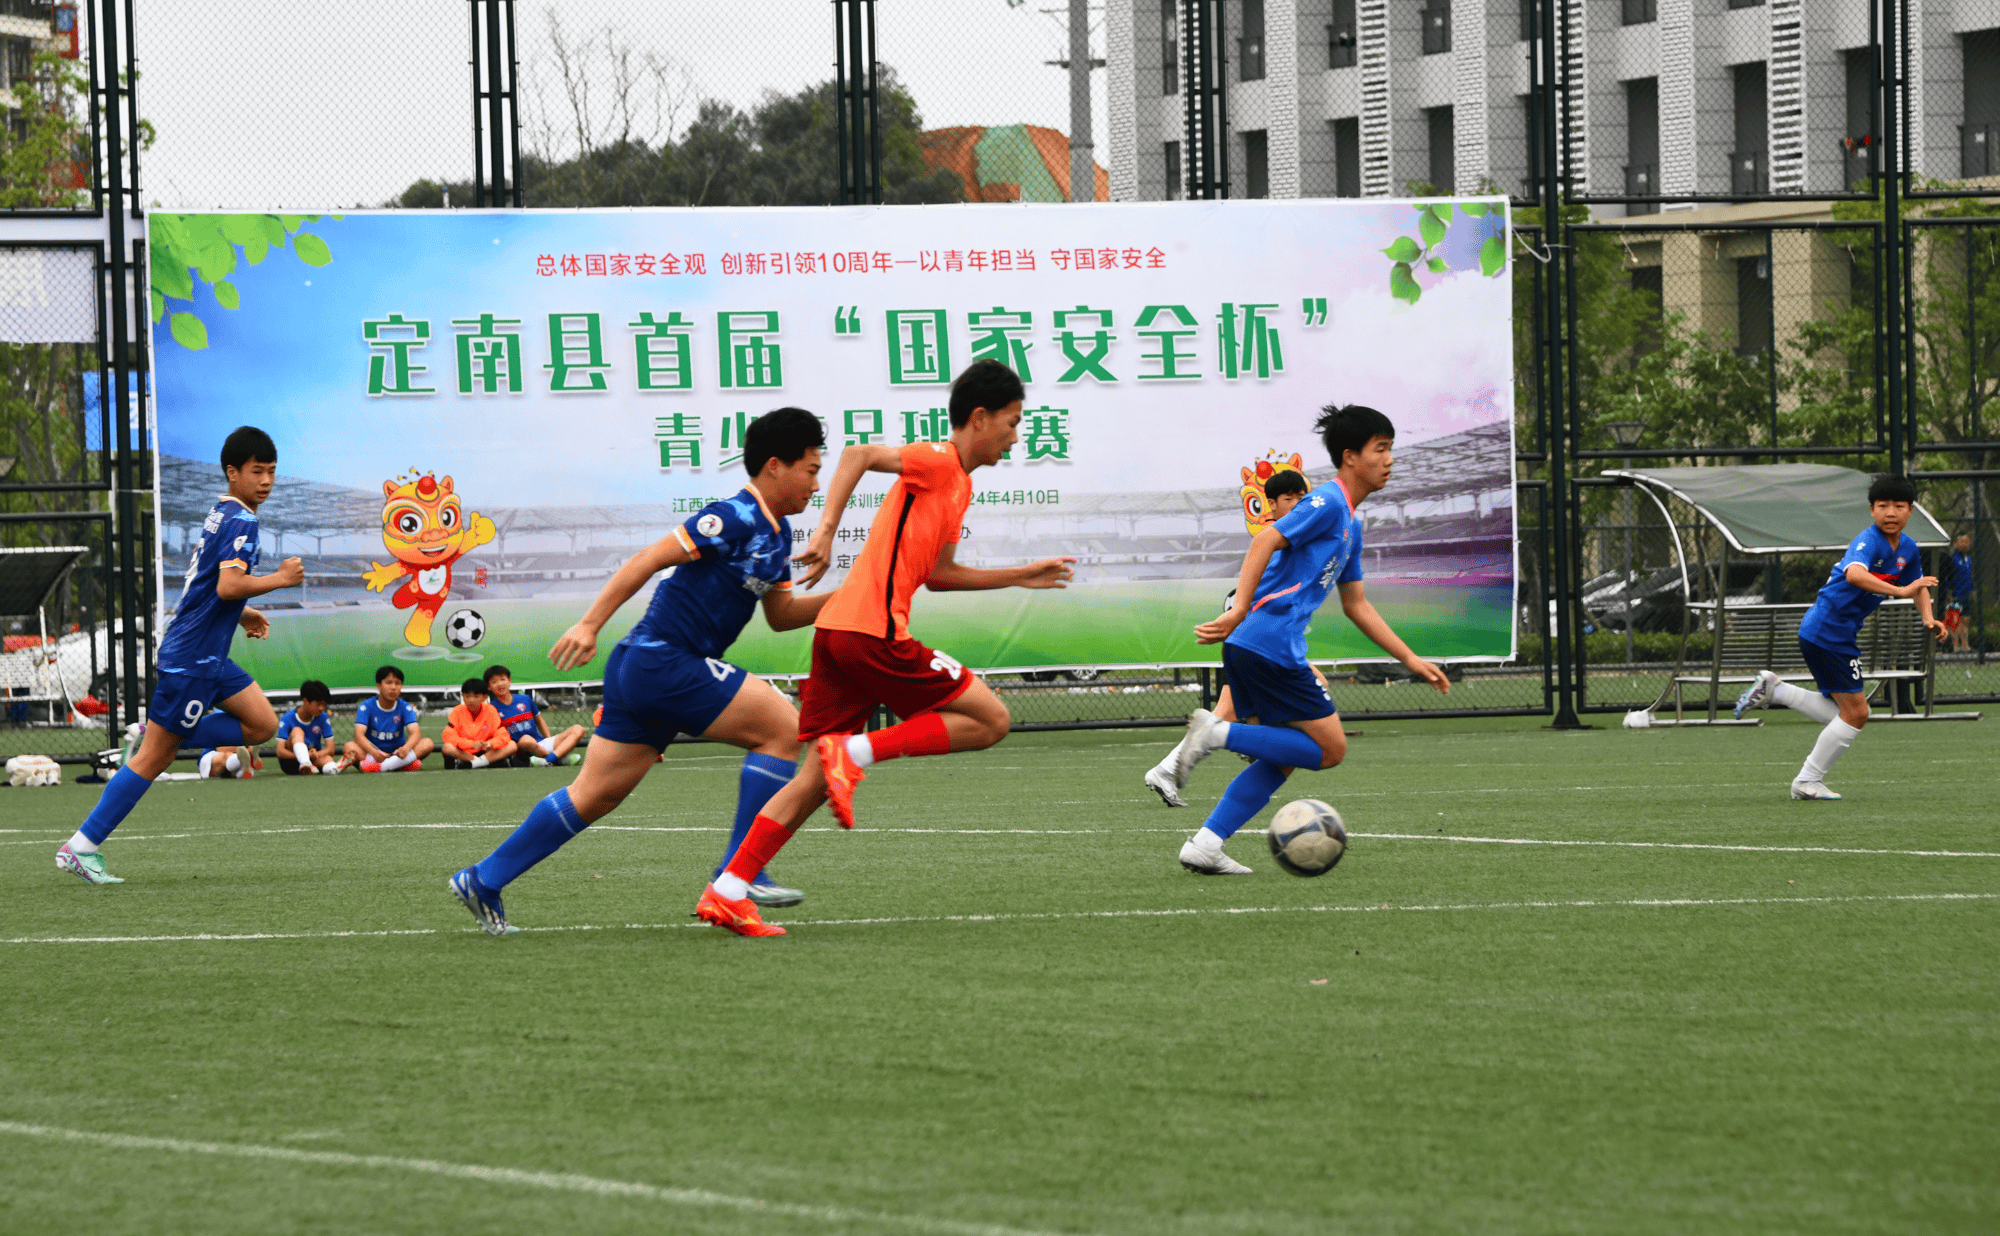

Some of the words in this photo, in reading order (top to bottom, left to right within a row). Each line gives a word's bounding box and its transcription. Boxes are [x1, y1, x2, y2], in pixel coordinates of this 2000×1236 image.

[536, 252, 707, 277] 总体国家安全观
[1050, 247, 1167, 270] 守国家安全
[704, 656, 737, 682] 4
[179, 699, 204, 729] 9
